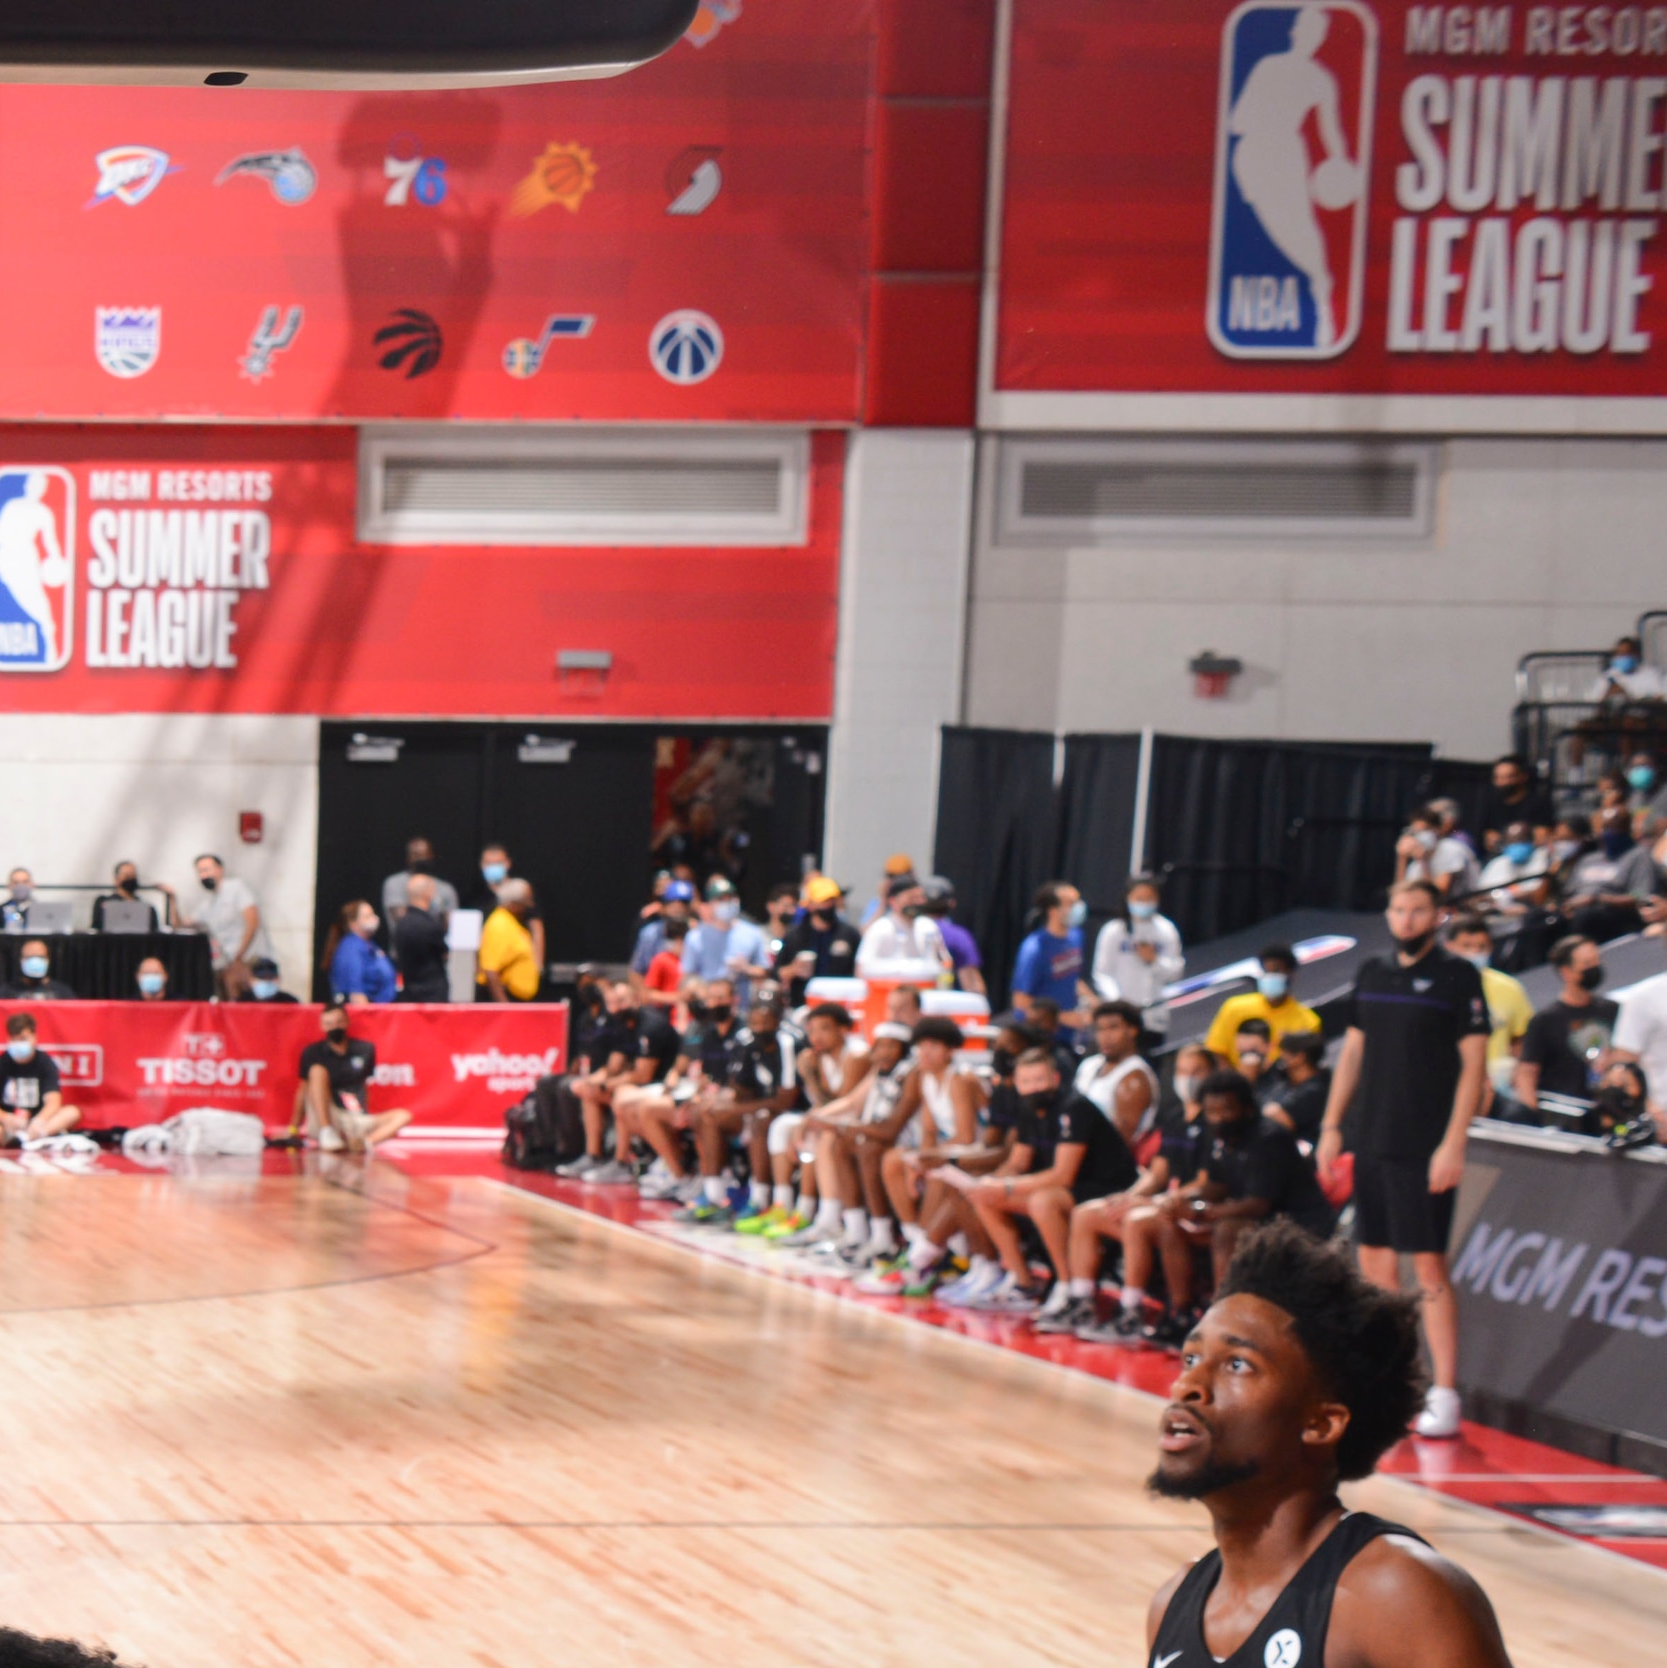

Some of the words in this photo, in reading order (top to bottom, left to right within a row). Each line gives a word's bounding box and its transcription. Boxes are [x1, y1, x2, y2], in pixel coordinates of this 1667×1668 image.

[1405, 7, 1510, 54] MGM
[1525, 8, 1667, 56] RESOR
[1397, 75, 1667, 212] SUMME
[383, 157, 448, 205] 76
[1229, 277, 1300, 331] NBA
[1387, 218, 1657, 353] LEAGUE
[89, 472, 149, 500] MGM
[158, 471, 272, 501] RESORTS
[87, 509, 270, 589] SUMMER
[86, 590, 238, 668] LEAGUE
[136, 1058, 267, 1086] TISSOT
[1451, 1222, 1590, 1311] MGM
